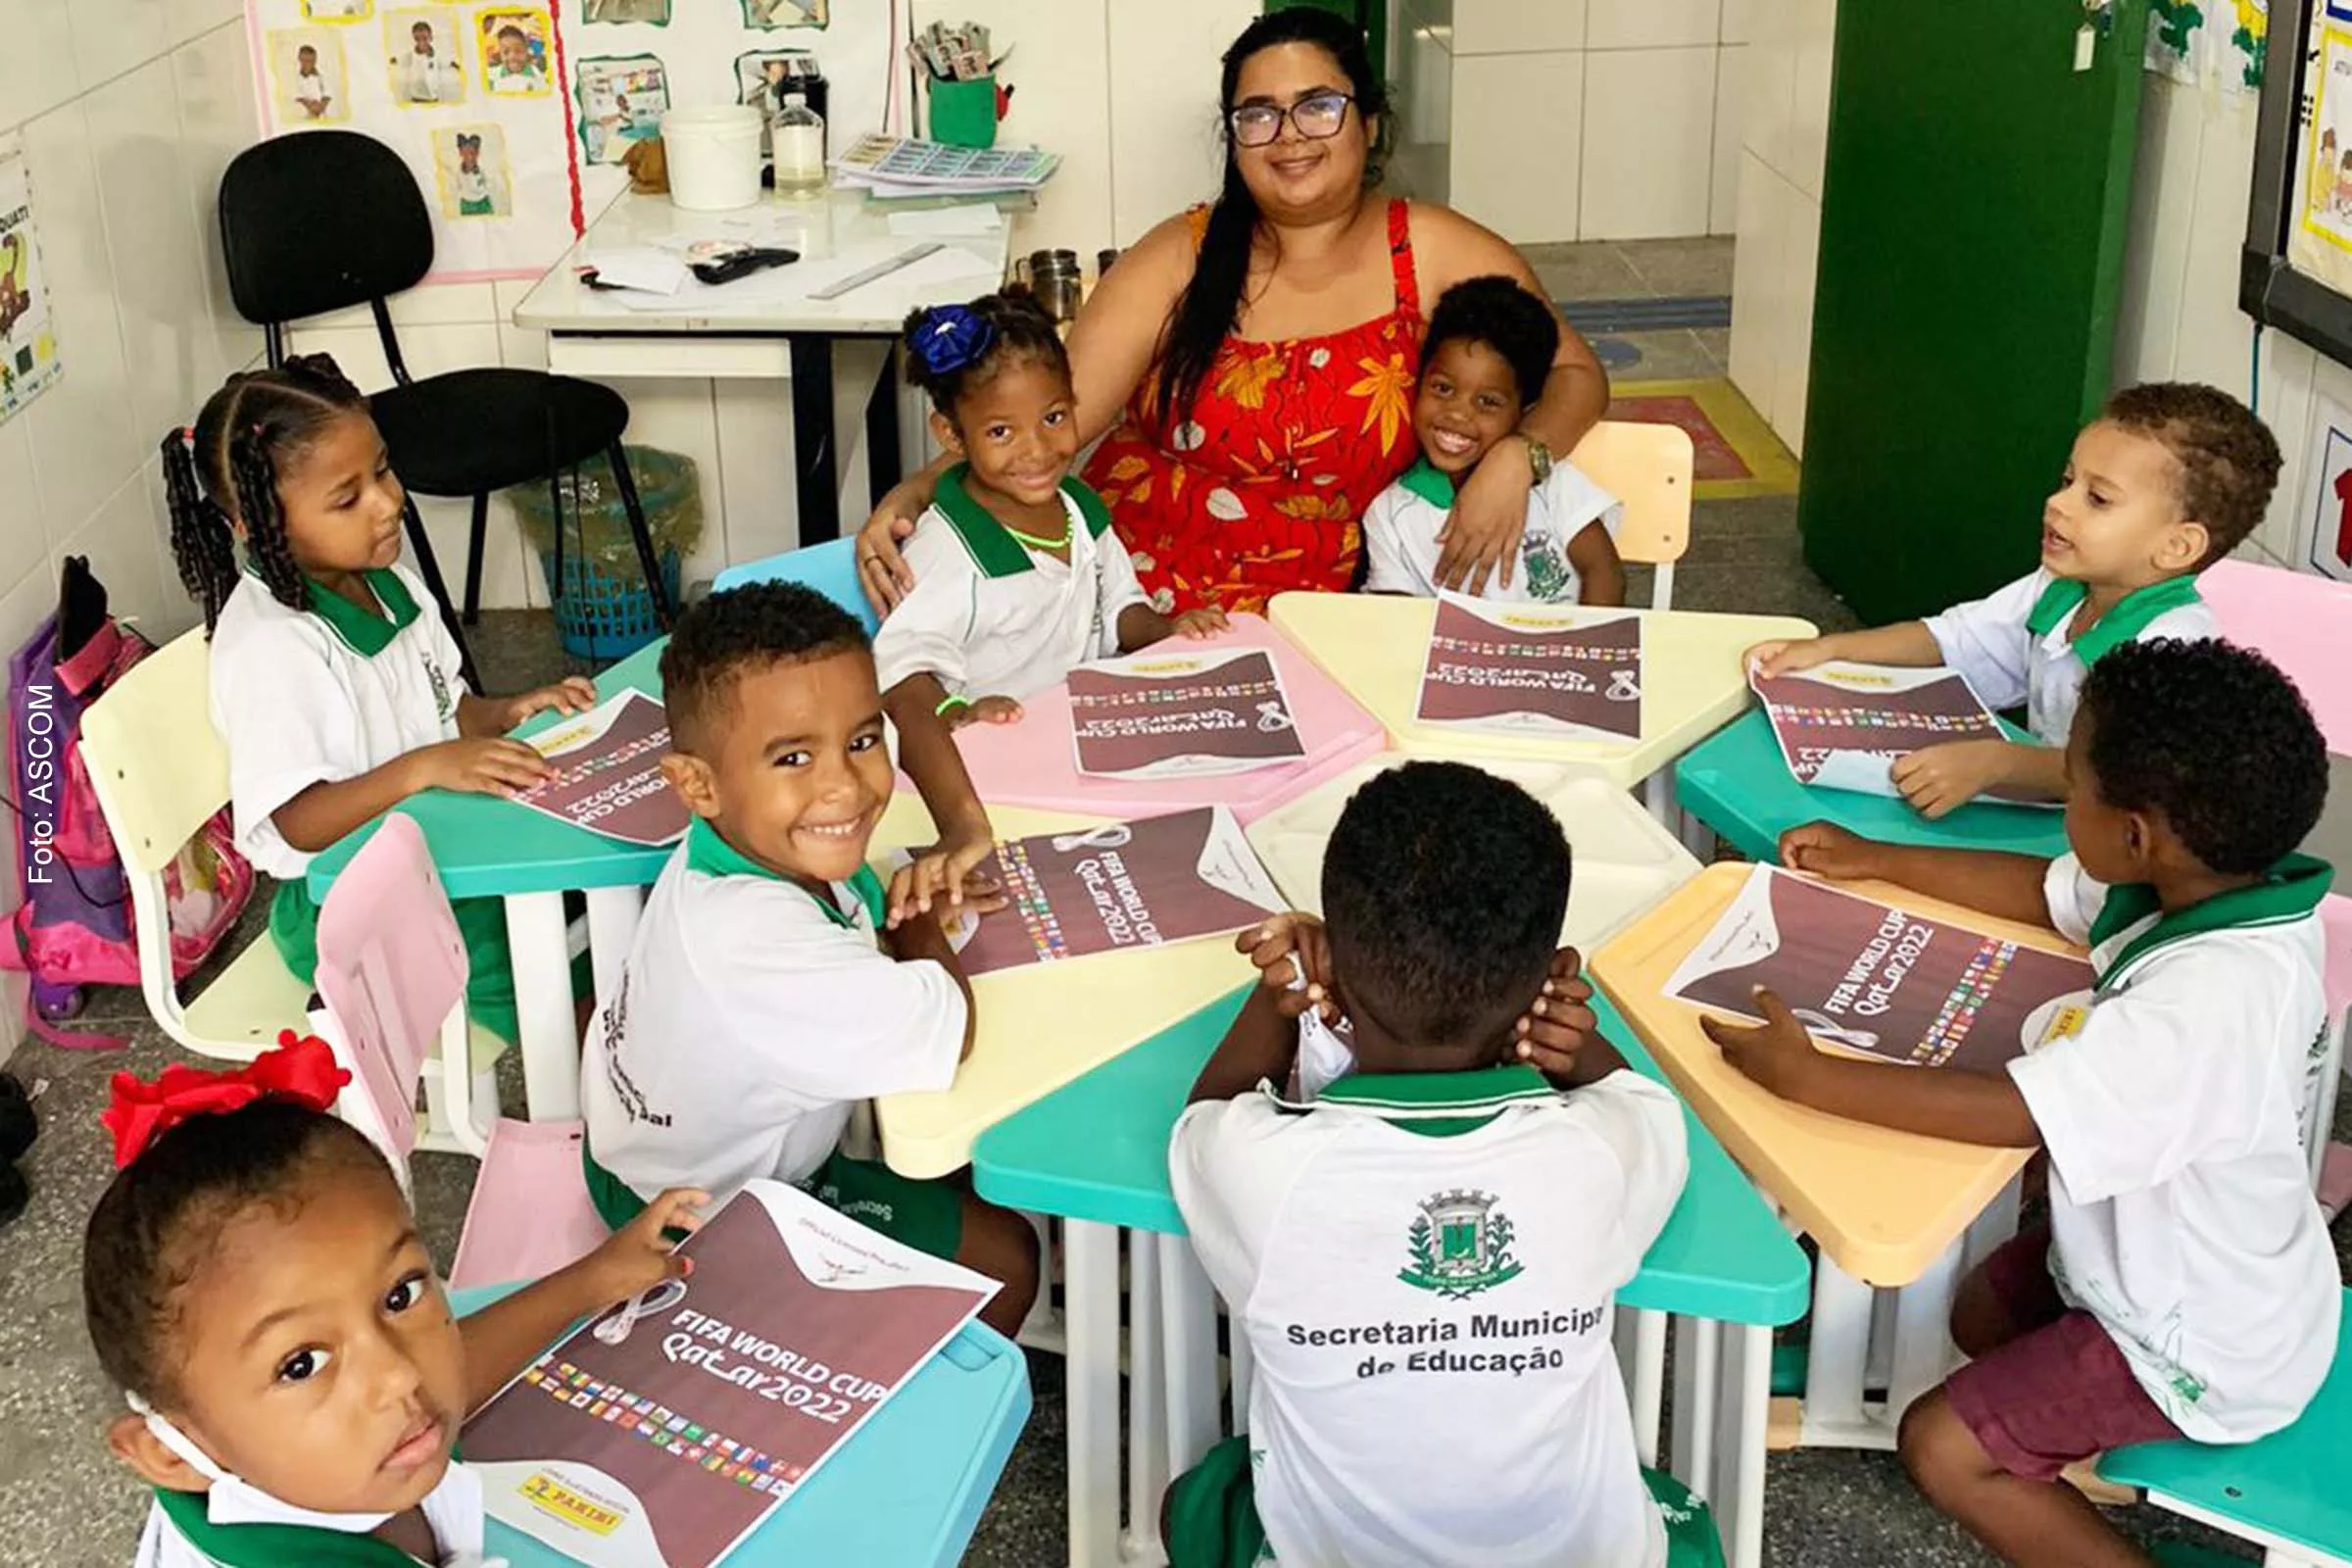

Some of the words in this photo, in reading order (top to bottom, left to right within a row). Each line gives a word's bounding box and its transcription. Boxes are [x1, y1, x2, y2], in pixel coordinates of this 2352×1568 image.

[1099, 851, 1127, 879] FIFA
[1112, 875, 1149, 921] WORLD
[1823, 982, 1862, 1015] FIFA
[1843, 938, 1891, 983] WORLD
[1878, 908, 1908, 940] CUP
[1287, 1317, 1458, 1347] Secretaria
[671, 1308, 733, 1345] FIFA
[730, 1331, 830, 1384] WORLD
[829, 1373, 890, 1402] CUP
[1356, 1355, 1396, 1378] de
[1406, 1347, 1564, 1377] Educação
